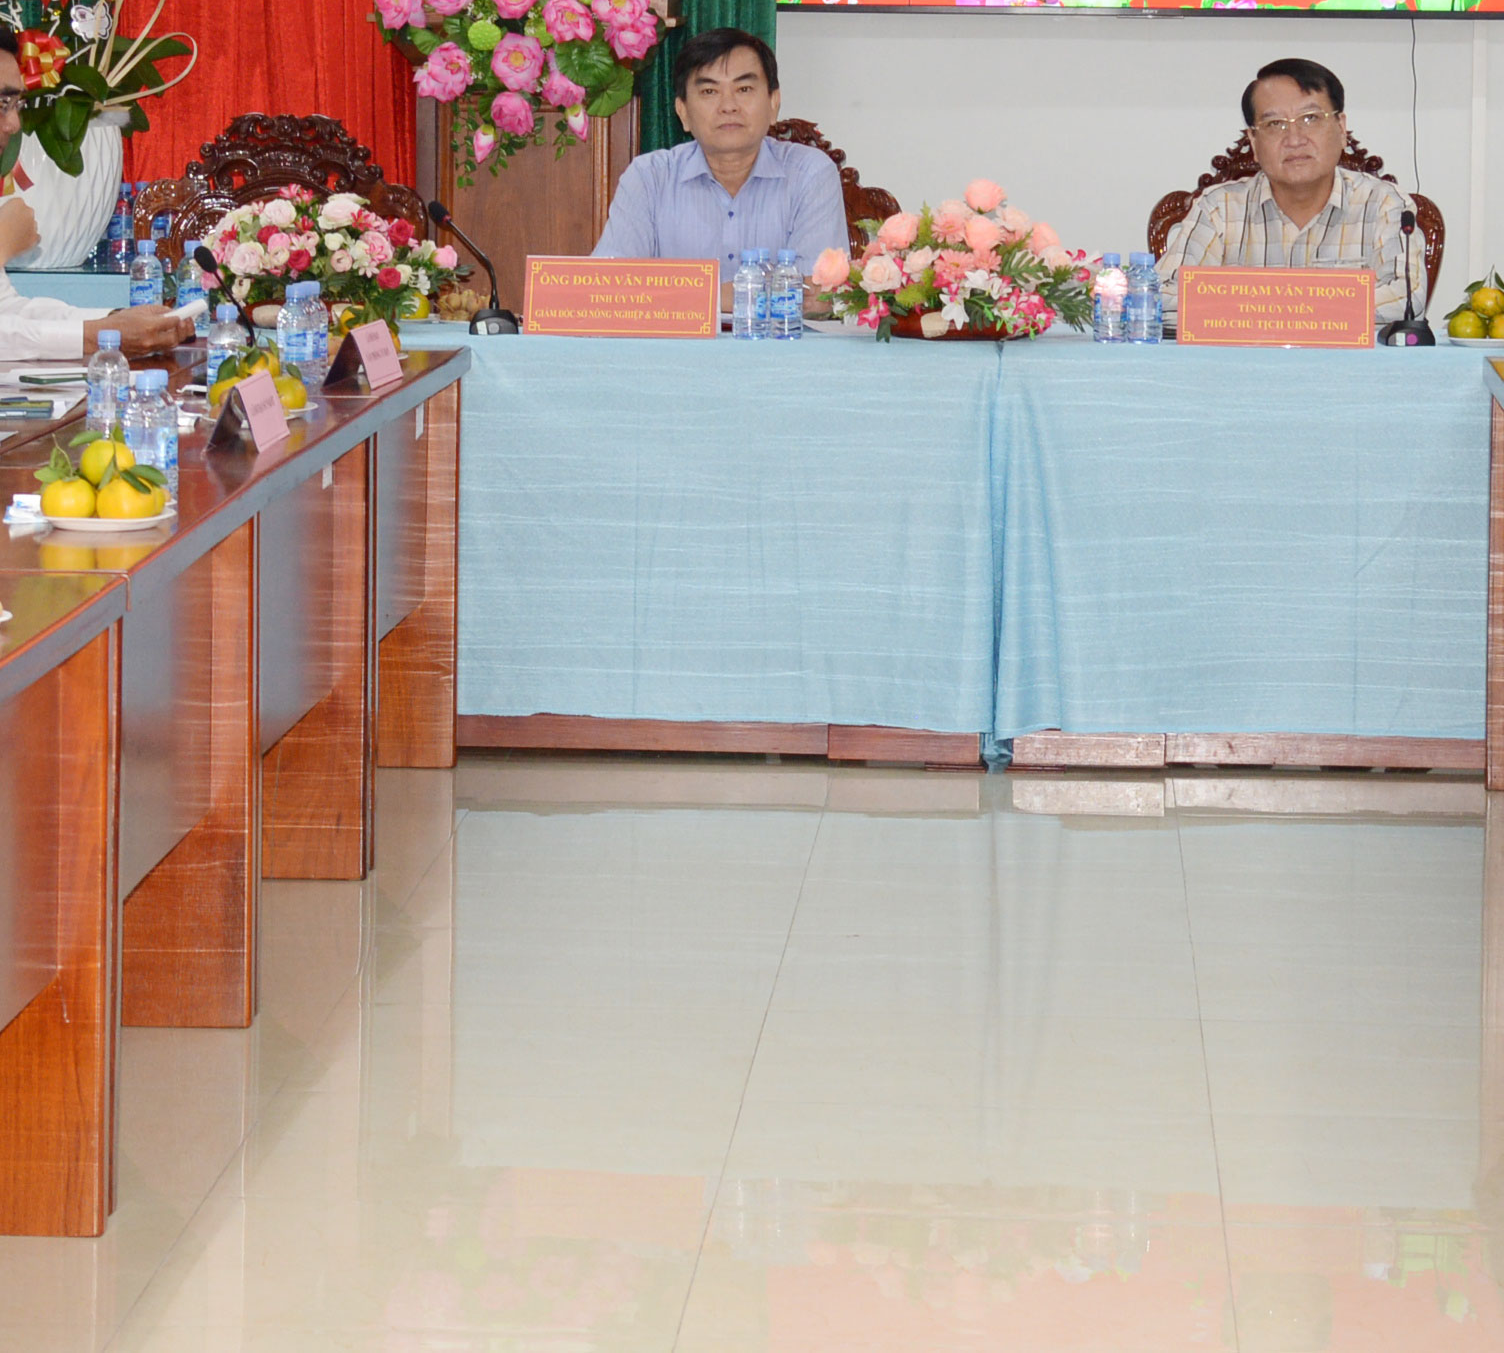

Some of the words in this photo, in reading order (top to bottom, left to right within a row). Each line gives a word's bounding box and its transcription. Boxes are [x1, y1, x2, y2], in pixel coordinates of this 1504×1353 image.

[1196, 280, 1227, 295] ÔNG
[1230, 284, 1272, 299] PHẠM
[1307, 286, 1356, 300] TRỌNG
